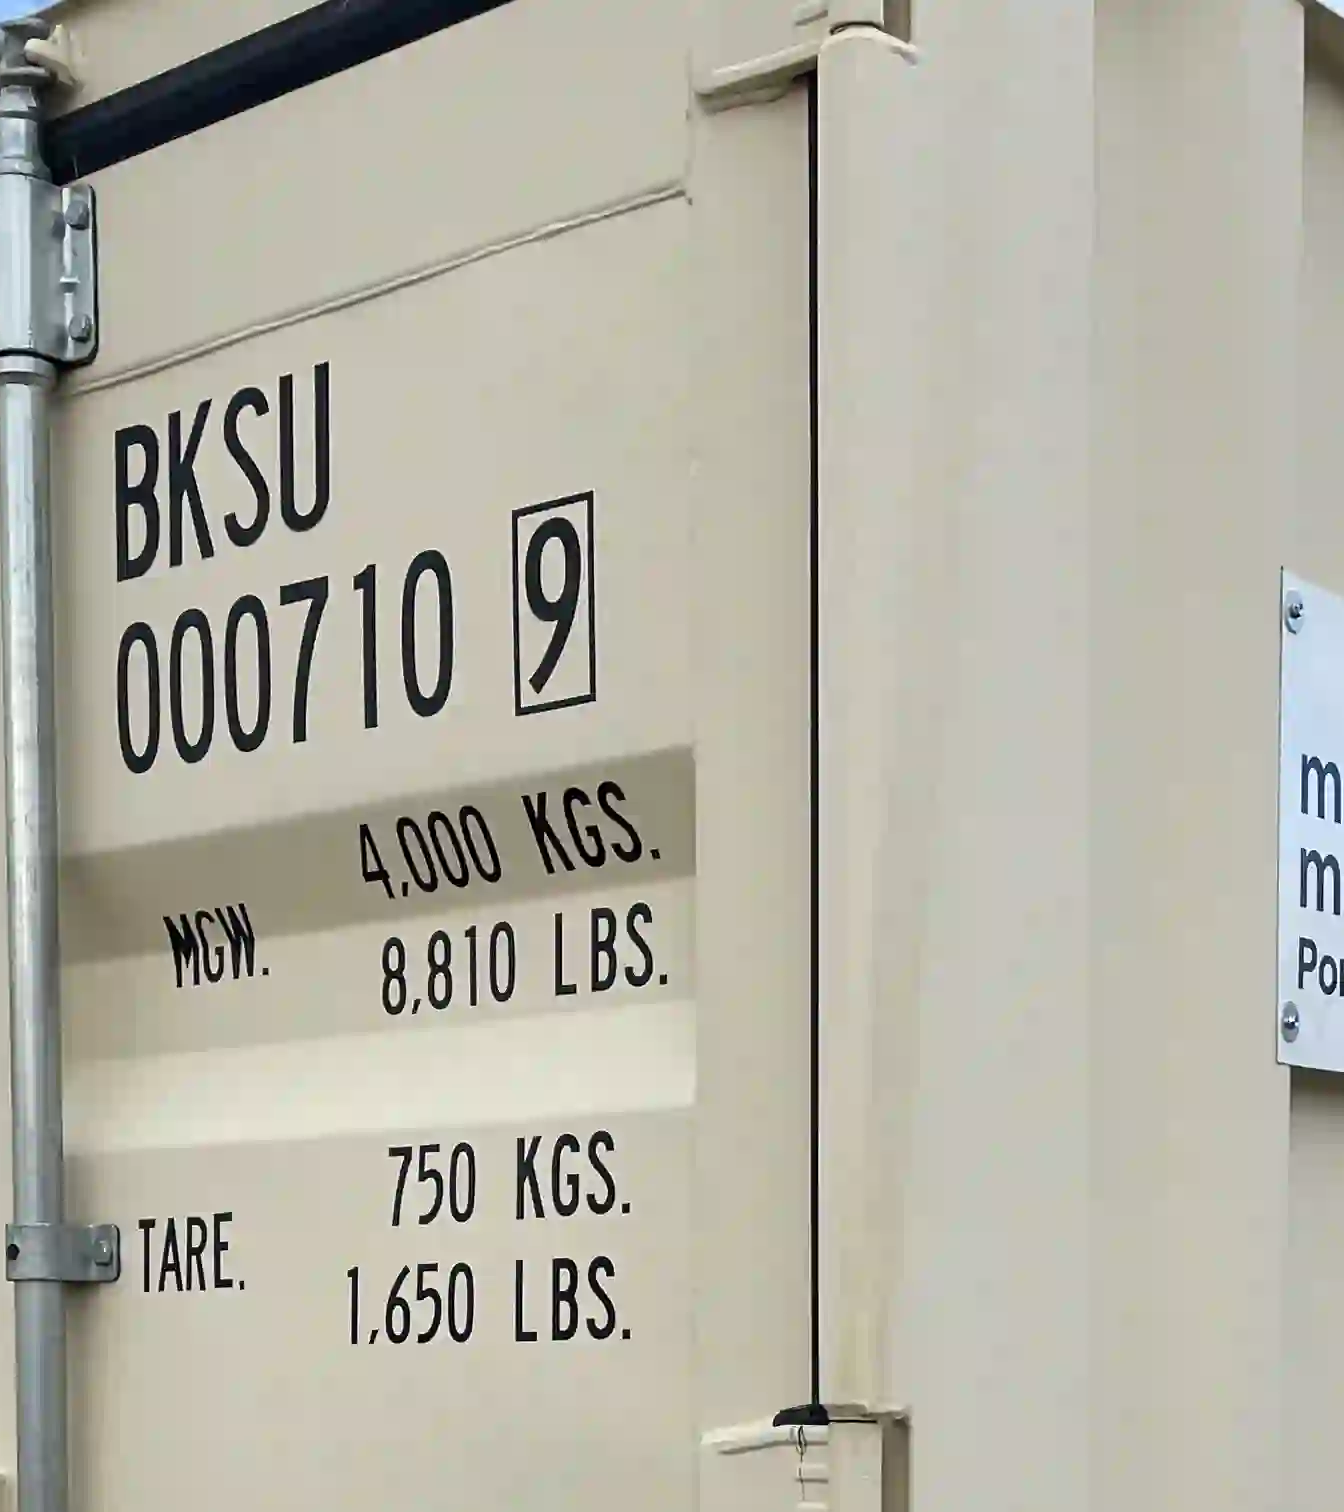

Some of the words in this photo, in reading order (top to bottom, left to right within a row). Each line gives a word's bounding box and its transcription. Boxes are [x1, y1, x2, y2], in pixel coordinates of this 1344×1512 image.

[114, 360, 330, 582] BKSU
[116, 549, 454, 774] 000710
[523, 517, 582, 695] 9
[520, 781, 661, 875] KGS.
[162, 902, 269, 989] MGW.
[382, 920, 516, 1016] 8,810
[554, 902, 668, 997] LBS.
[388, 1142, 476, 1227] 750
[515, 1130, 631, 1221] KGS.
[138, 1211, 245, 1293] TARE.
[347, 1262, 475, 1345] 1,650
[515, 1255, 631, 1342] LBS.
